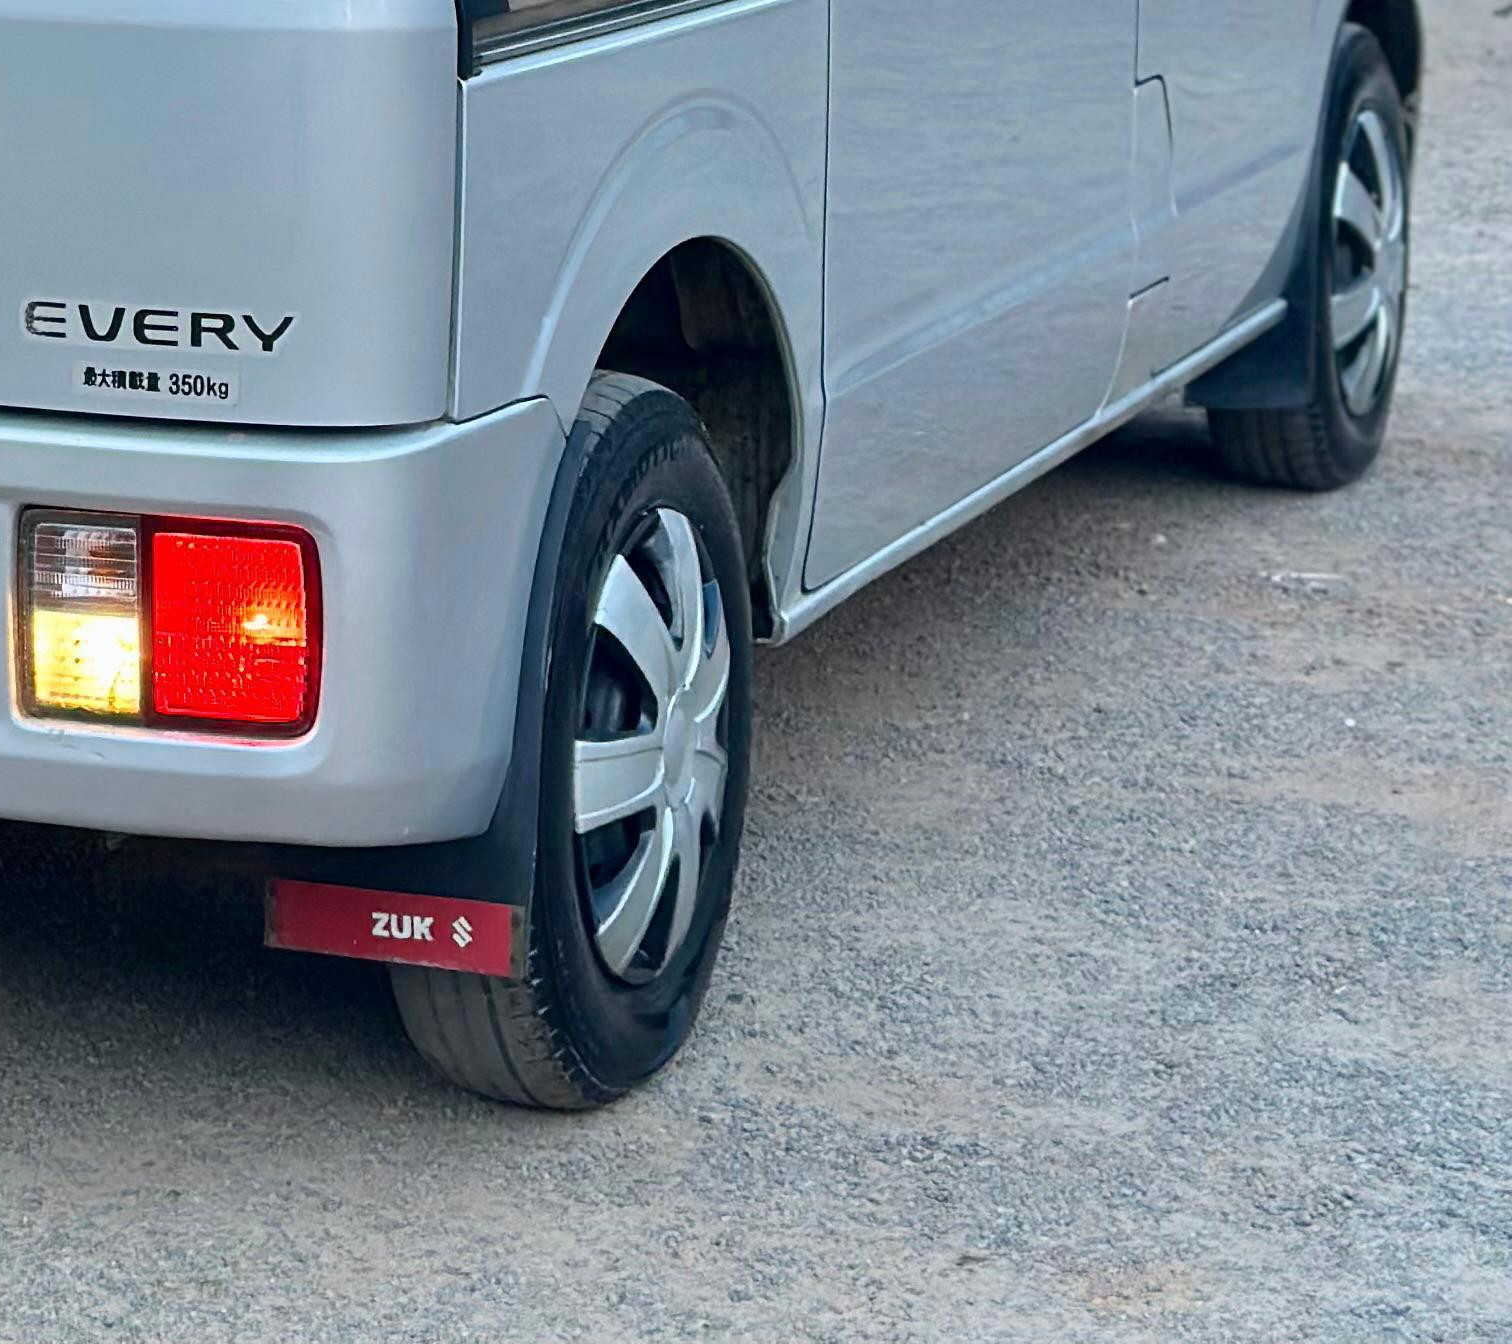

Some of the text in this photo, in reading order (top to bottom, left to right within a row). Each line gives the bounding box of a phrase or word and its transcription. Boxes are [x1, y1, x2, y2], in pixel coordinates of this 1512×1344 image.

[24, 301, 295, 352] EVERY
[168, 372, 229, 400] 350kg
[371, 911, 435, 942] ZUK
